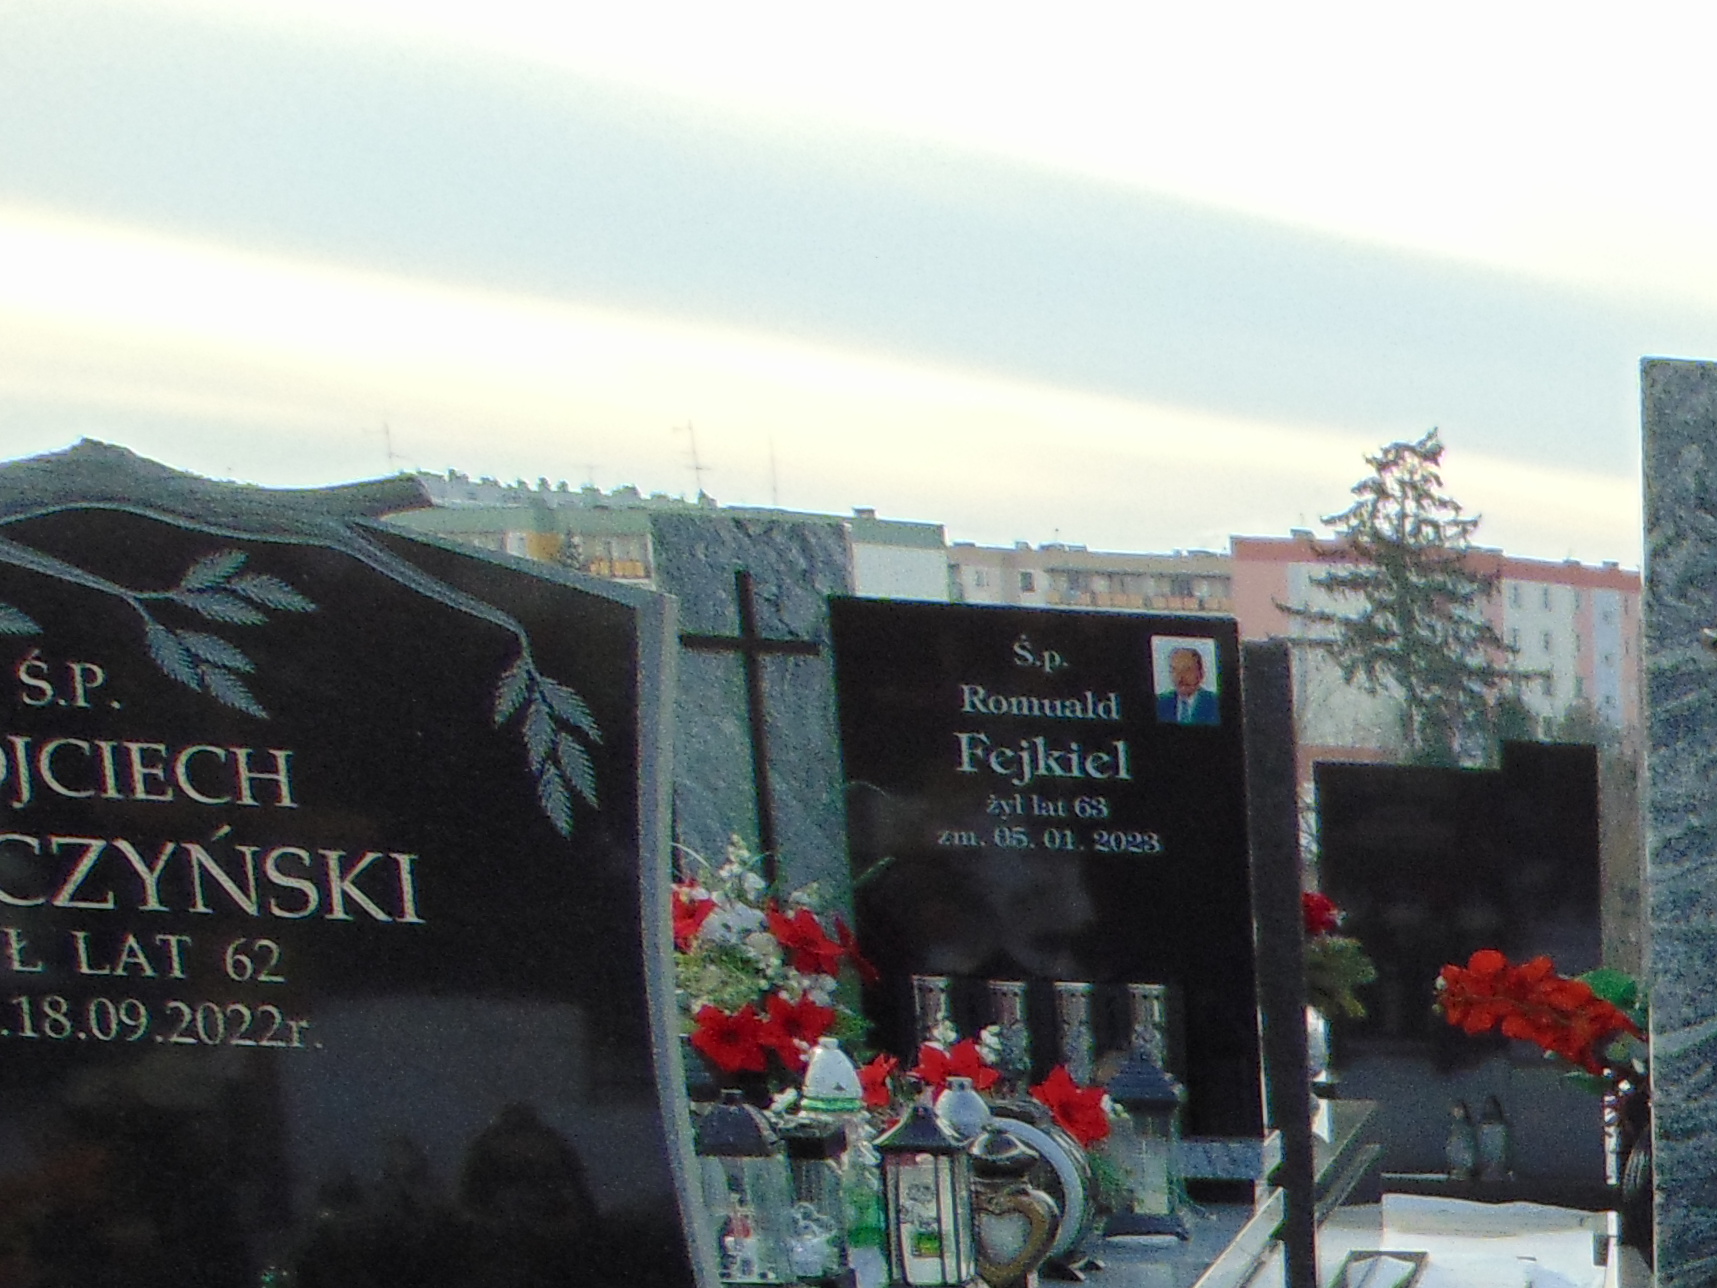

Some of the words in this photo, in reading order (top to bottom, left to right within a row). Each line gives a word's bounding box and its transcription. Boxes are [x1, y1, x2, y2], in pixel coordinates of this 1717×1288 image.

[16, 649, 122, 710] Ś.P.
[959, 683, 1122, 721] Romuald
[0, 734, 299, 810] JCIECH
[952, 731, 1134, 787] Fejkiel
[1032, 794, 1068, 817] lat
[0, 823, 427, 925] CZYŃSKI
[70, 930, 193, 980] LAT
[224, 937, 287, 983] 62
